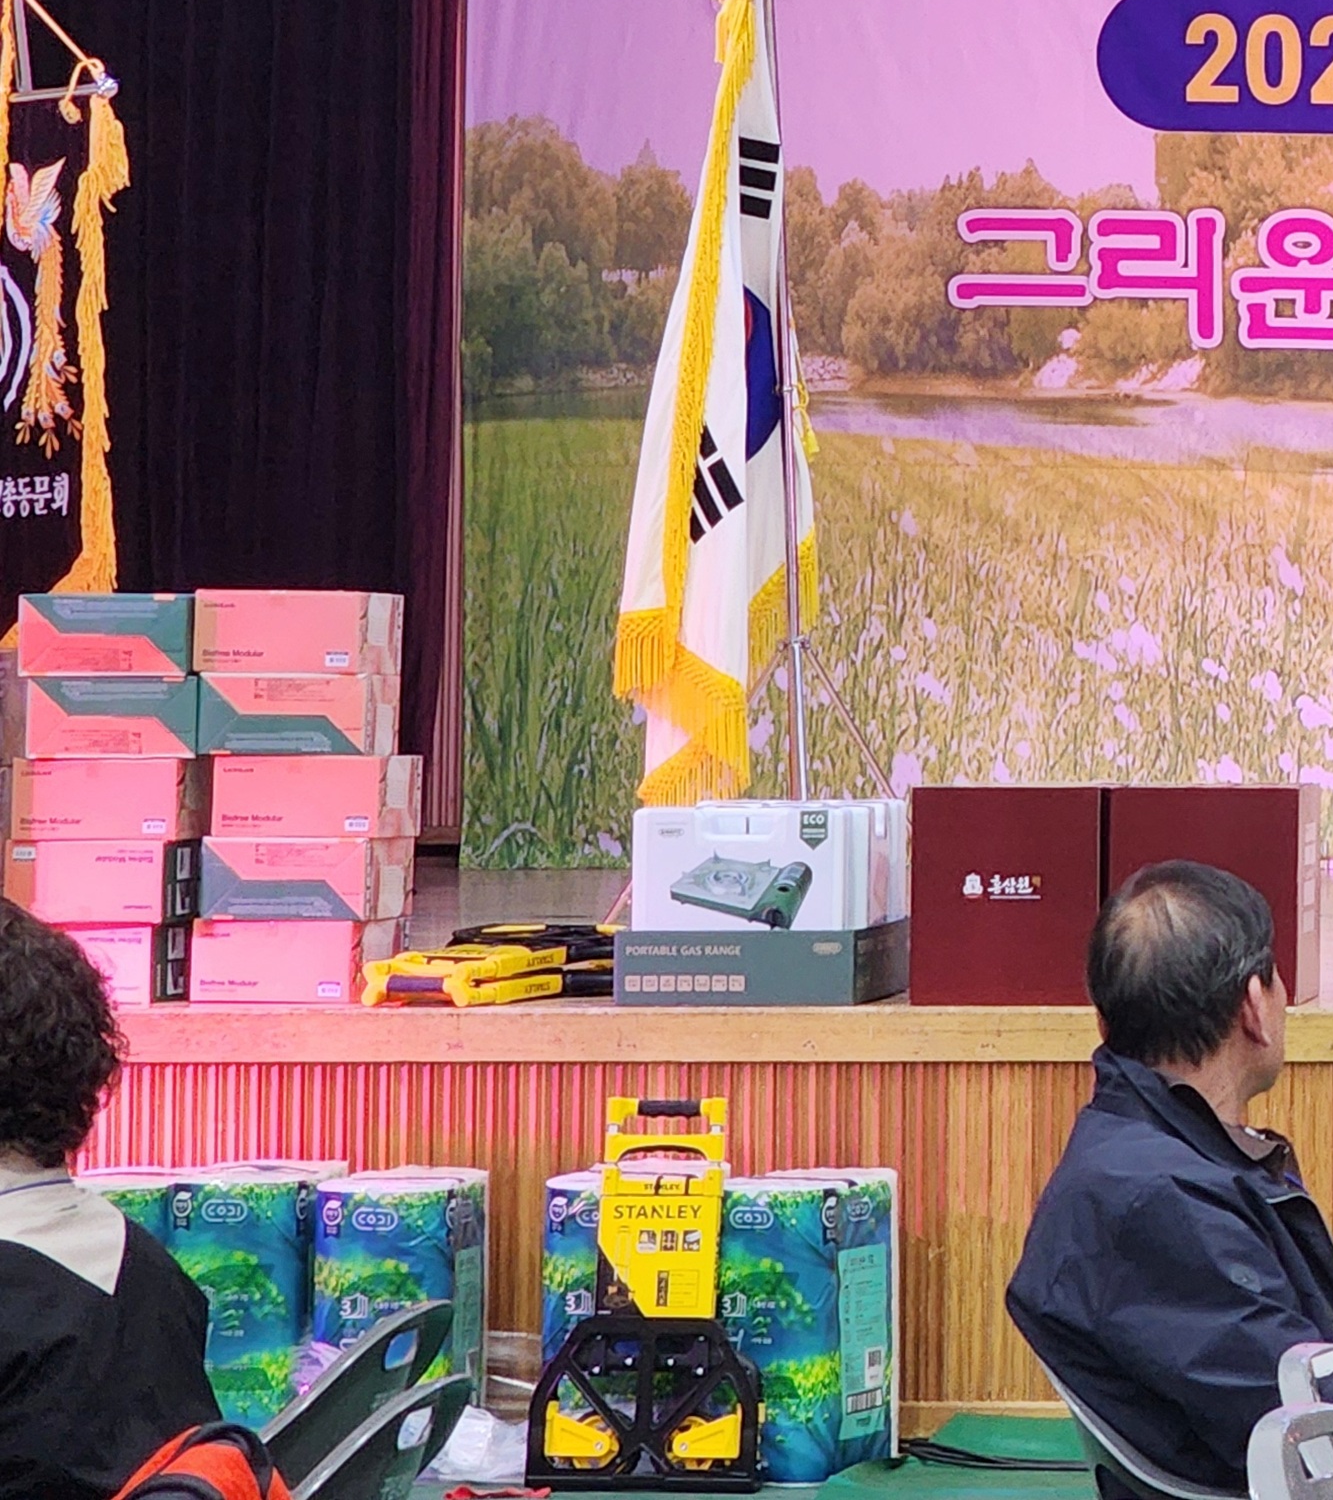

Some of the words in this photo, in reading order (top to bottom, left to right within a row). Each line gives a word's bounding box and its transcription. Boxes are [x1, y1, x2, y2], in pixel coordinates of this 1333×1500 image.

[0, 472, 69, 518] 총동문회
[803, 814, 825, 825] ECO
[625, 945, 678, 956] PORTABLE
[680, 945, 702, 956] GAS
[704, 945, 741, 956] RANGE
[613, 1204, 702, 1219] STANLEY
